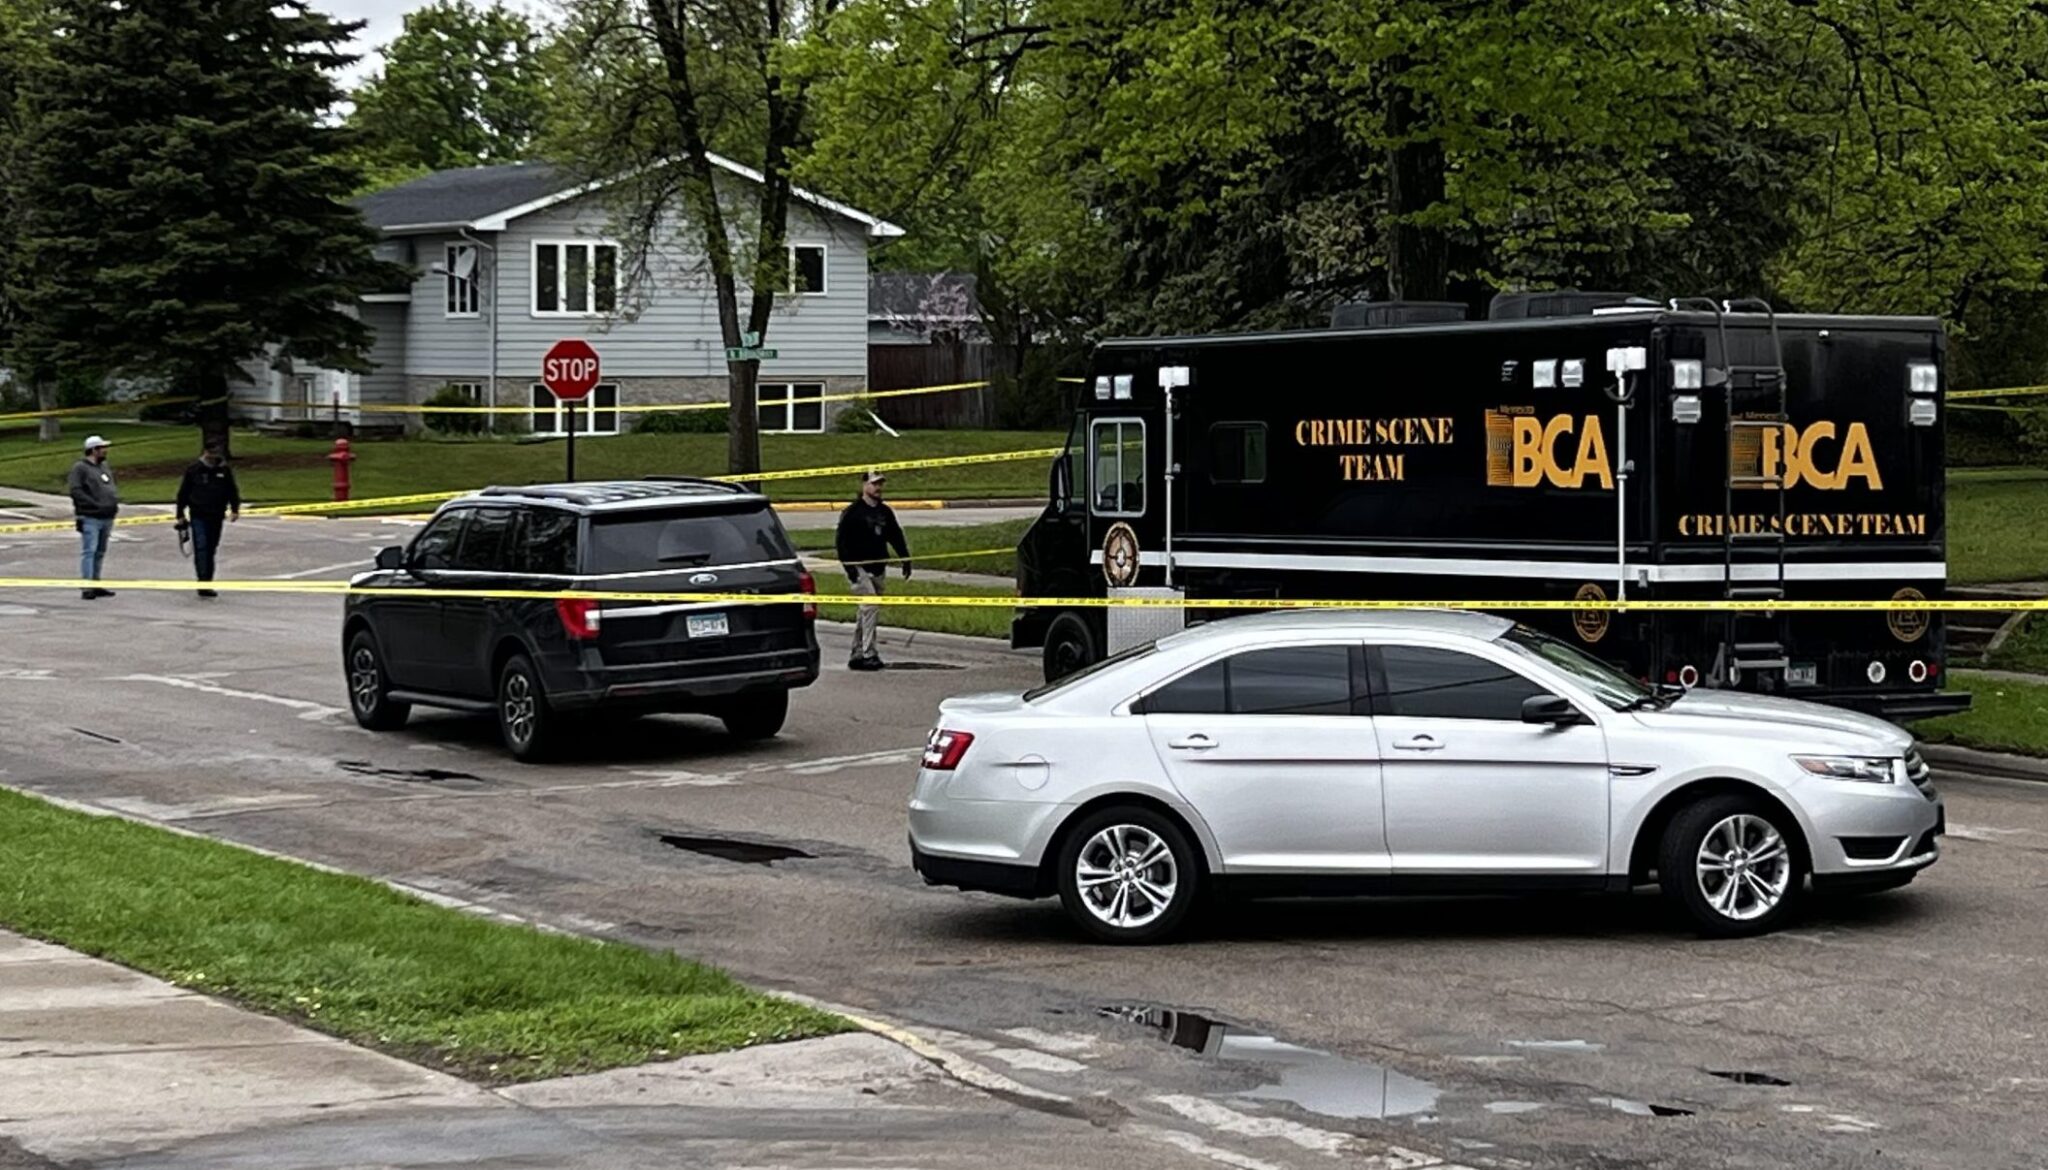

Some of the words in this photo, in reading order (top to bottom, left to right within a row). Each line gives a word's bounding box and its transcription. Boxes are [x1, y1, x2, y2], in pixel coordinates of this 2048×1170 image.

[546, 358, 597, 381] STOP
[1295, 419, 1371, 446] CRIME
[1375, 417, 1454, 445] SCENE
[1513, 414, 1614, 489] BCA
[1763, 420, 1883, 490] BCA
[1340, 454, 1404, 480] TEAM
[1678, 514, 1765, 536] CRIME
[1770, 513, 1852, 536] SCENE
[1857, 514, 1926, 535] TEAM
